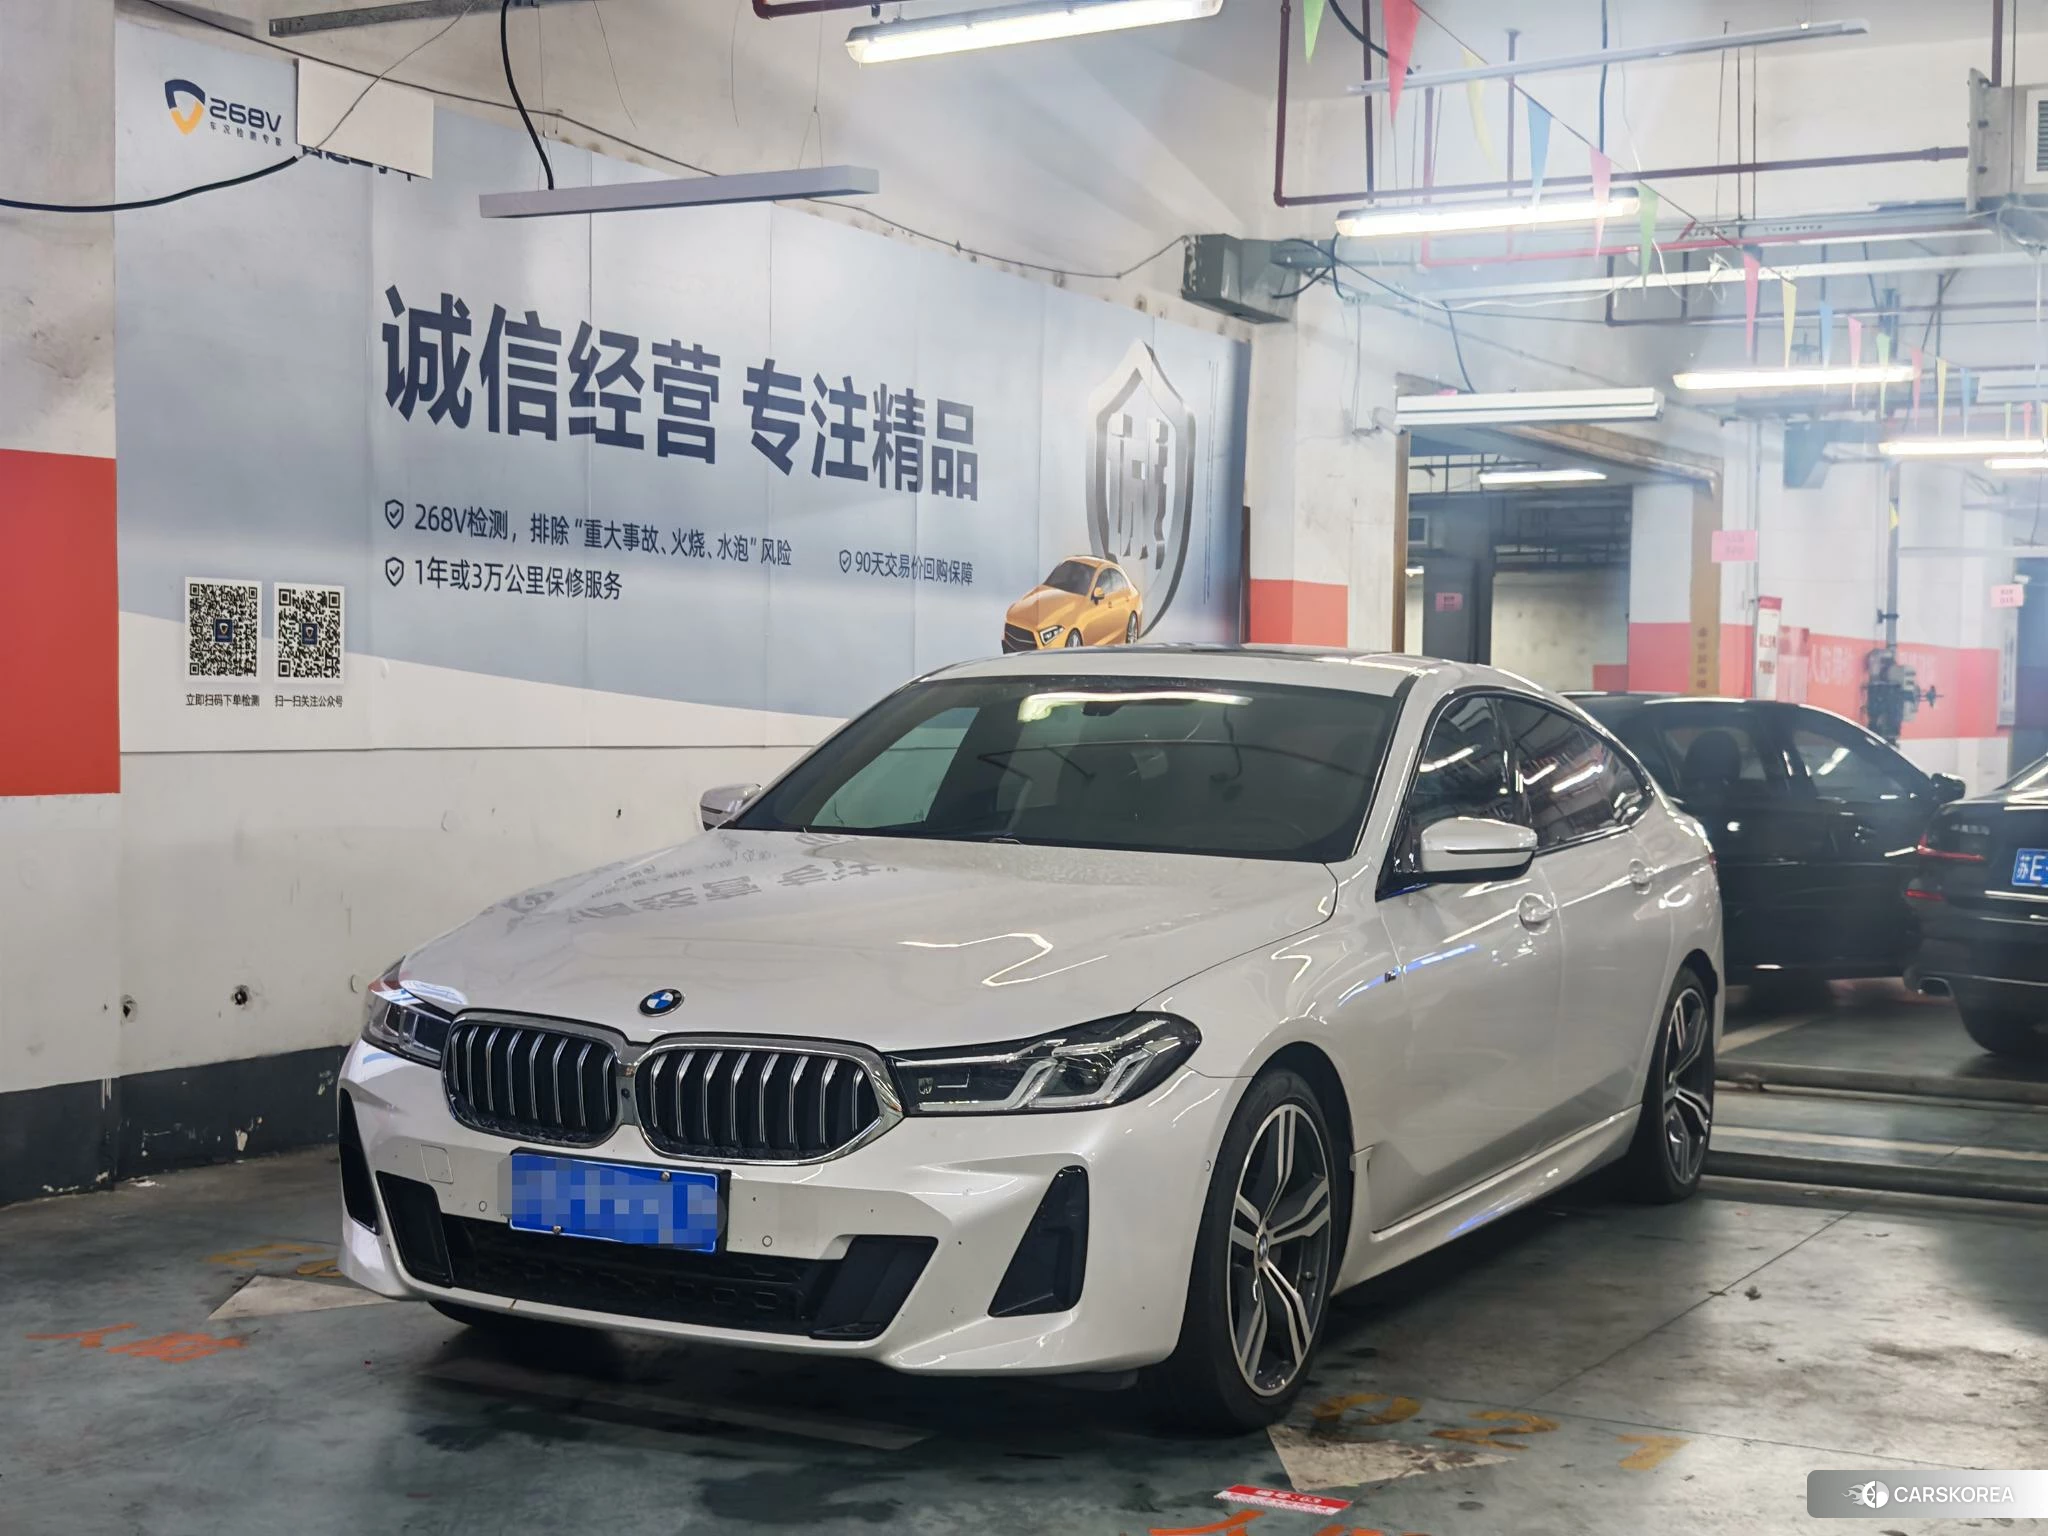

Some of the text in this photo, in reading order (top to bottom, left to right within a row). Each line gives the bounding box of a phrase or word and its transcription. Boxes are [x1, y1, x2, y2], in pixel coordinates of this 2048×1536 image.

[209, 97, 282, 132] 268V
[382, 284, 980, 502] 诚信经营 专注精品
[414, 555, 623, 600] 1年或3万公里保修服务
[855, 551, 974, 586] 90天交易价回购保障
[185, 693, 260, 707] 立即扫码下单检测
[274, 695, 343, 708] 扫一扫关注公众号
